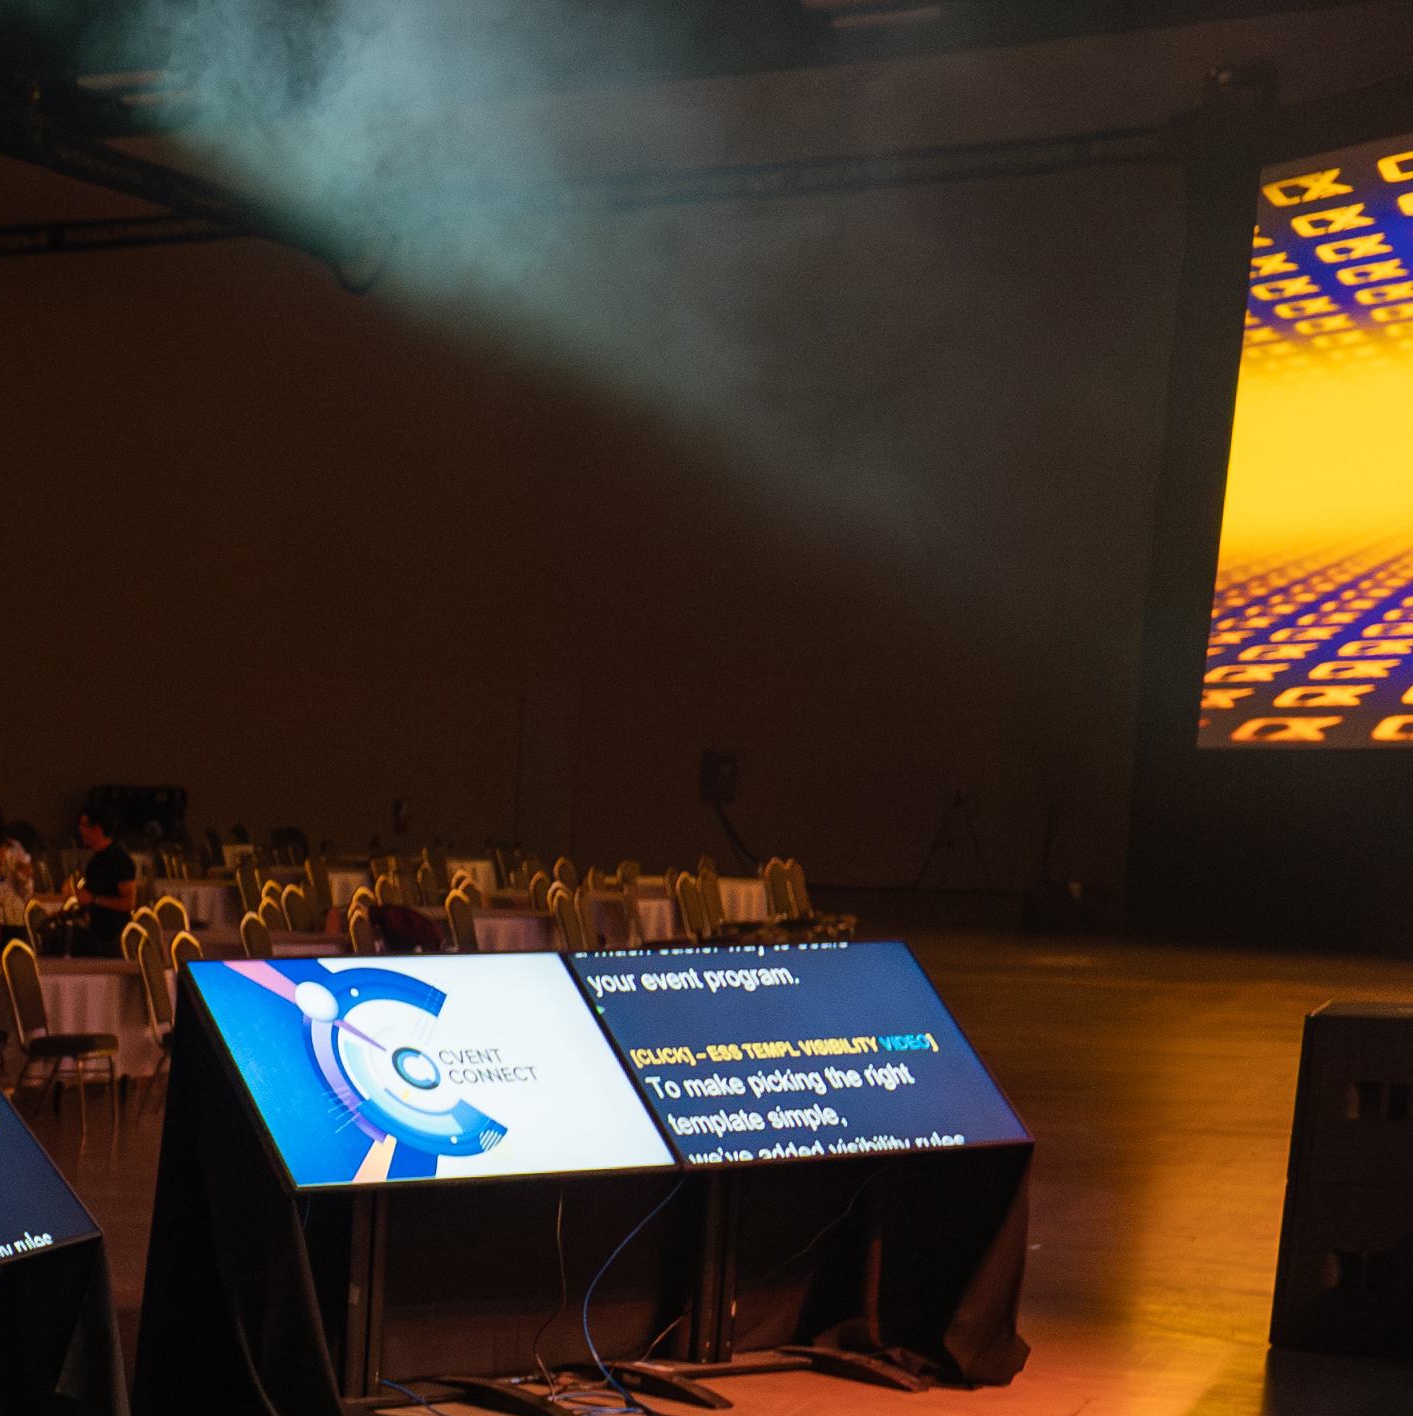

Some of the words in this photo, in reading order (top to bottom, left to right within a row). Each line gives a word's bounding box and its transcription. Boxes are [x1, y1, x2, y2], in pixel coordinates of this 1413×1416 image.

[586, 973, 637, 999] your
[640, 967, 705, 991] event
[702, 967, 800, 994] program.
[438, 1048, 503, 1066] CVENT
[629, 1046, 697, 1069] [CLICK]
[705, 1043, 744, 1062] ESS
[740, 1040, 802, 1060] TEMPL
[797, 1035, 879, 1057] VISIBILITY
[878, 1032, 940, 1053] VIDEO]
[448, 1065, 538, 1085] CONNECT
[644, 1075, 682, 1100] To
[682, 1072, 746, 1098] make
[746, 1068, 828, 1099] picking
[823, 1065, 863, 1089] the
[863, 1062, 916, 1091] right
[667, 1108, 766, 1138] template
[767, 1102, 848, 1132] simple,
